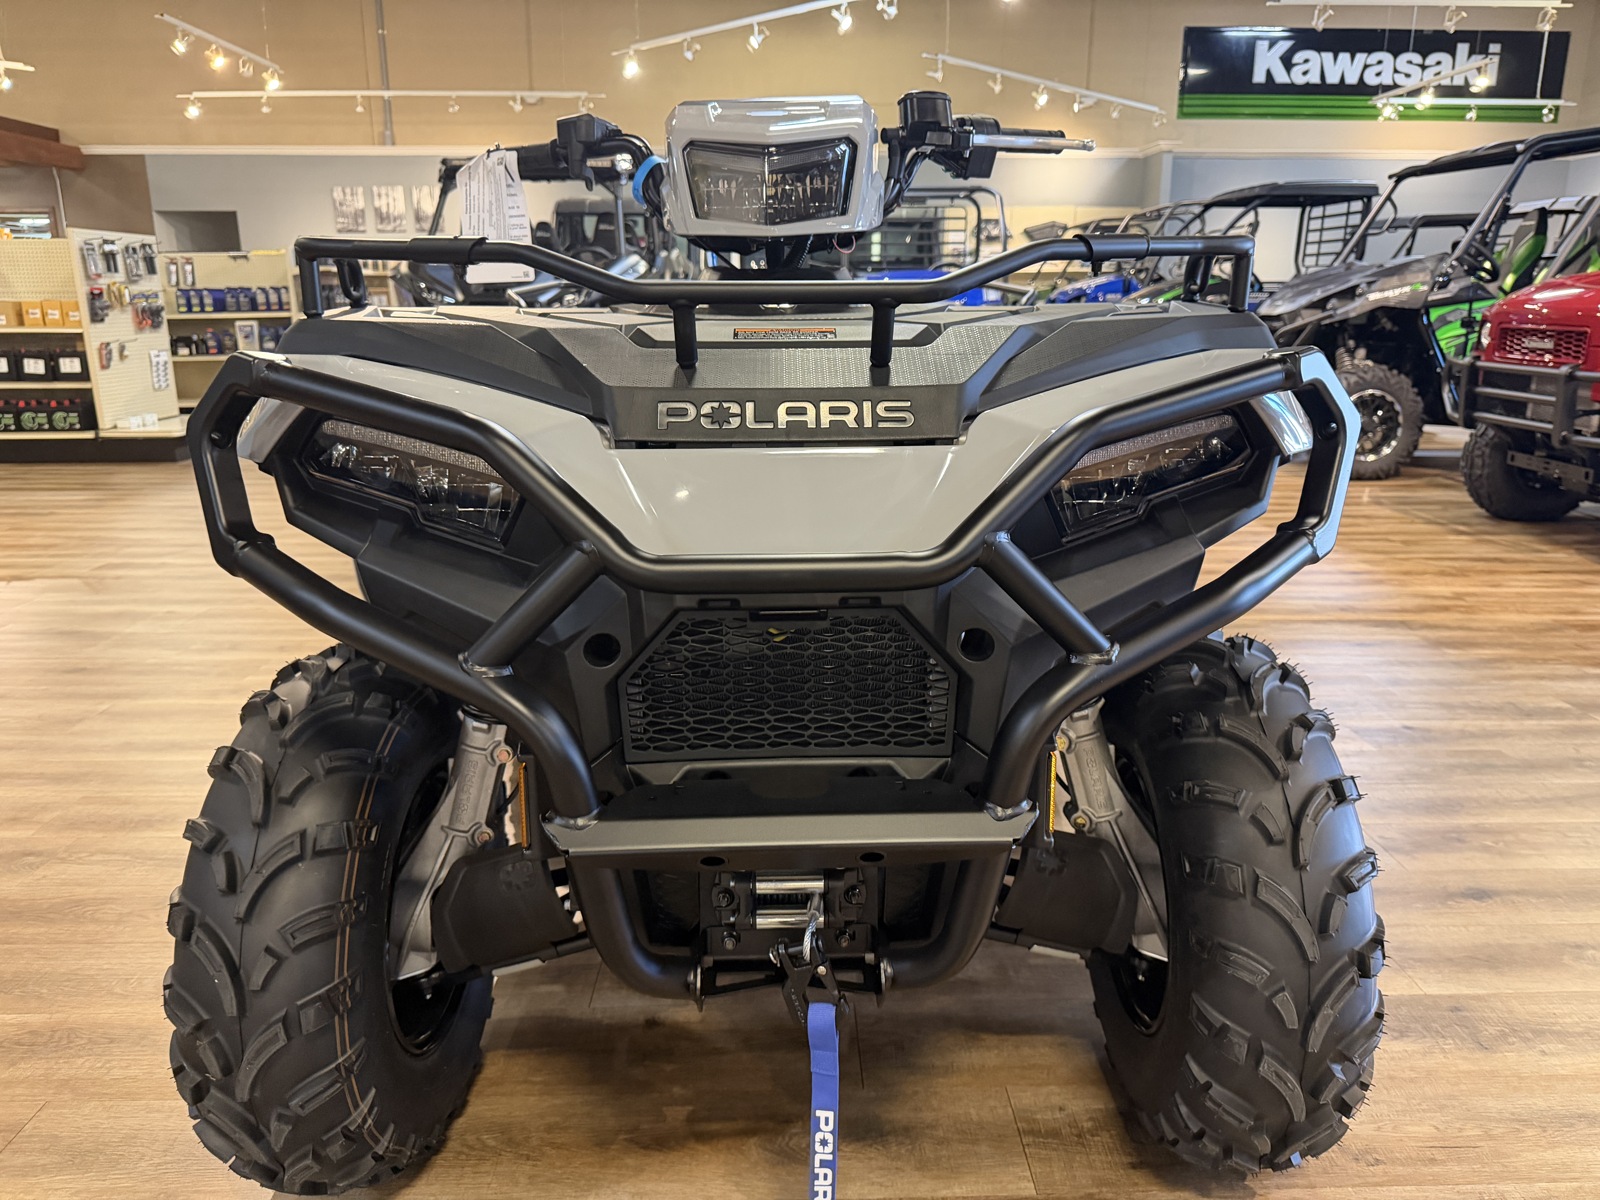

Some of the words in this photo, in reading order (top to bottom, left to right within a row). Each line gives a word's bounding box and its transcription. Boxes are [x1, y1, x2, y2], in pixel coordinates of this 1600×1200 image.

[1251, 38, 1502, 87] Kawasaki
[657, 400, 915, 430] POLARIS
[456, 759, 479, 826] POLARIS
[813, 1109, 835, 1200] POLAR
